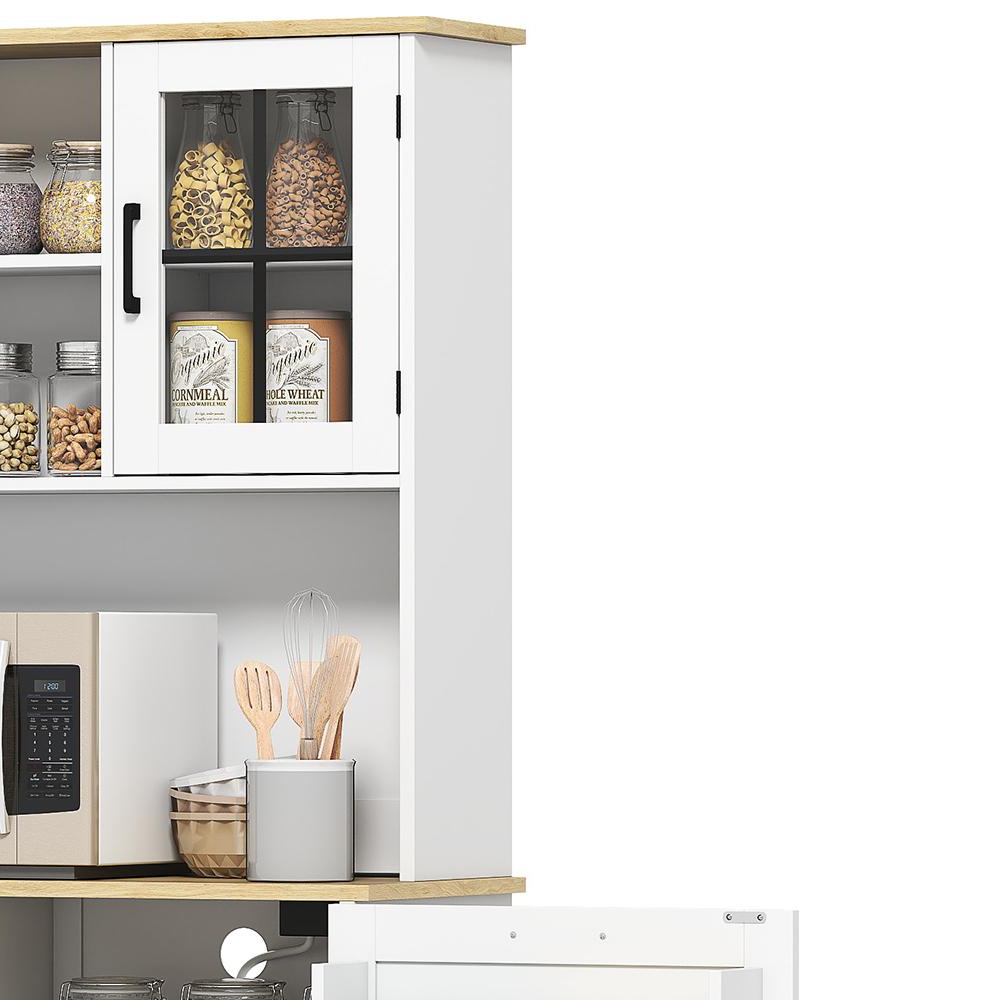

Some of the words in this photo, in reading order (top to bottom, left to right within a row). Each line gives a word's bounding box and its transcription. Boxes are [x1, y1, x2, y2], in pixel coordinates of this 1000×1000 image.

[171, 341, 225, 386] Organic
[171, 388, 229, 401] CORNMEAL
[287, 389, 325, 400] WHEAT
